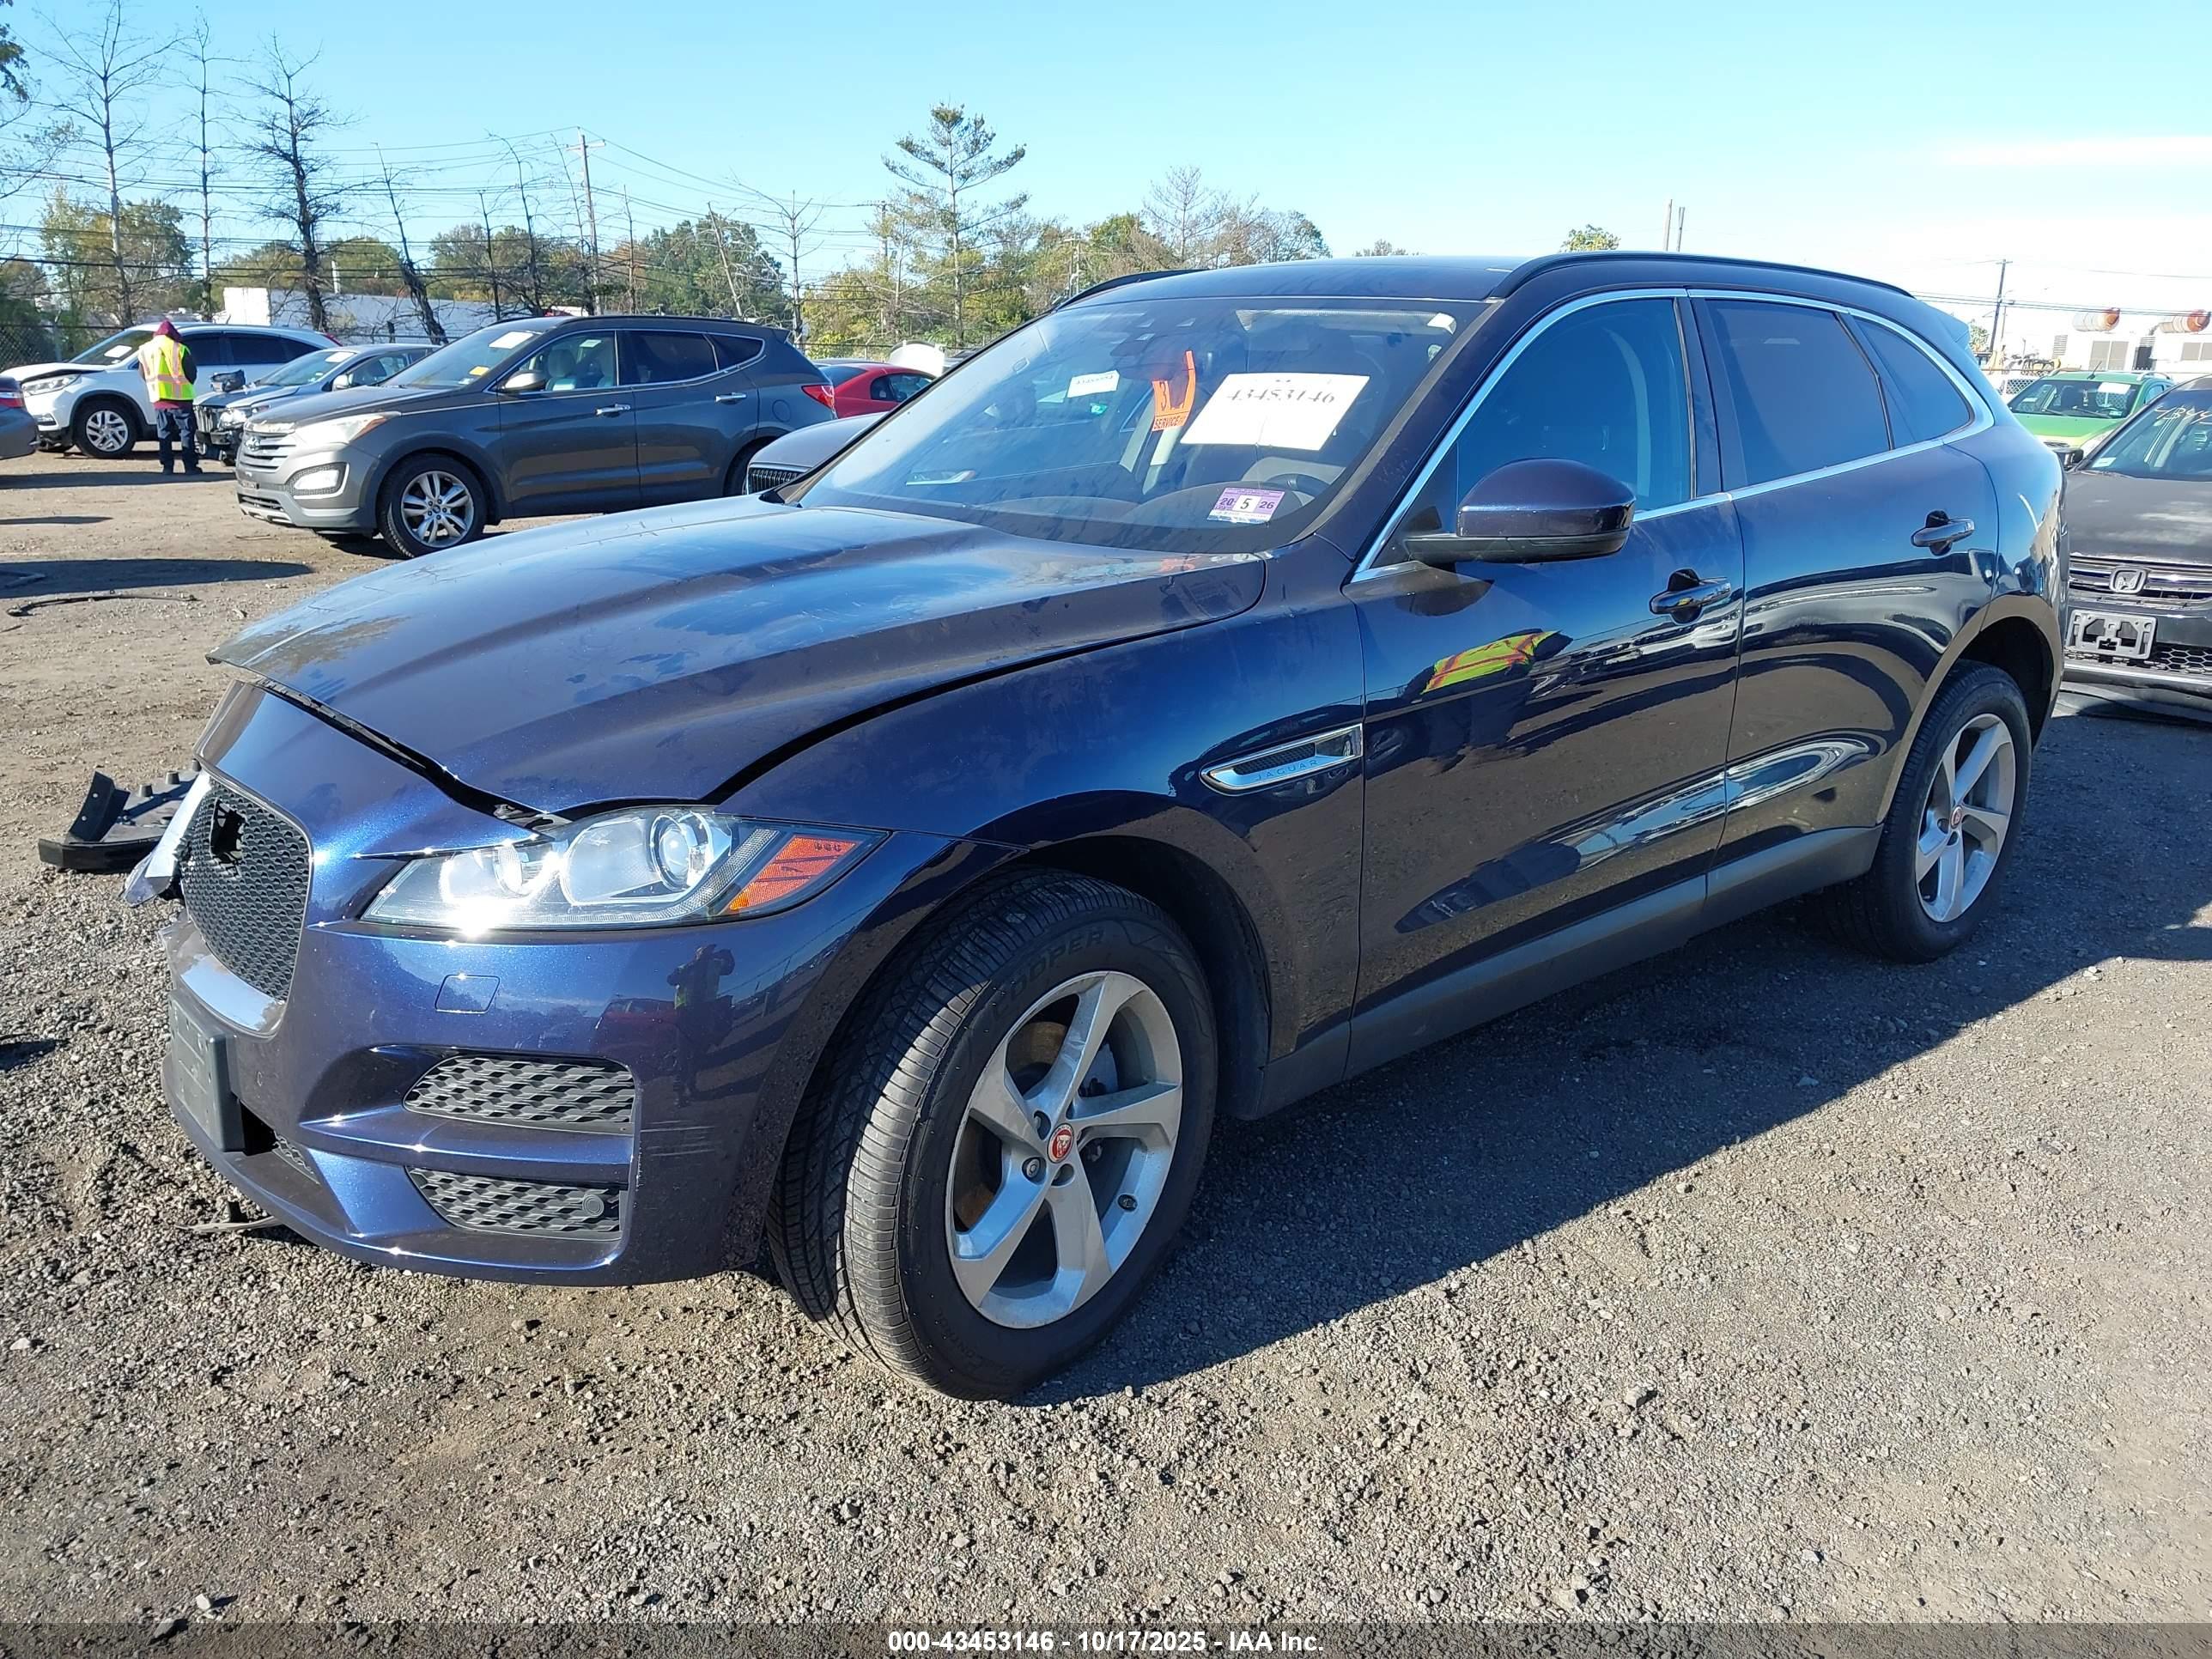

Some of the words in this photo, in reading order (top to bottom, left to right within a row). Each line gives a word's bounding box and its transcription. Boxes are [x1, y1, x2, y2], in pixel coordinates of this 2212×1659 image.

[1153, 415, 1181, 429] SERVICE
[1240, 498, 1254, 510] 5
[1259, 501, 1275, 509] 26
[1255, 759, 1319, 781] JAGUAR
